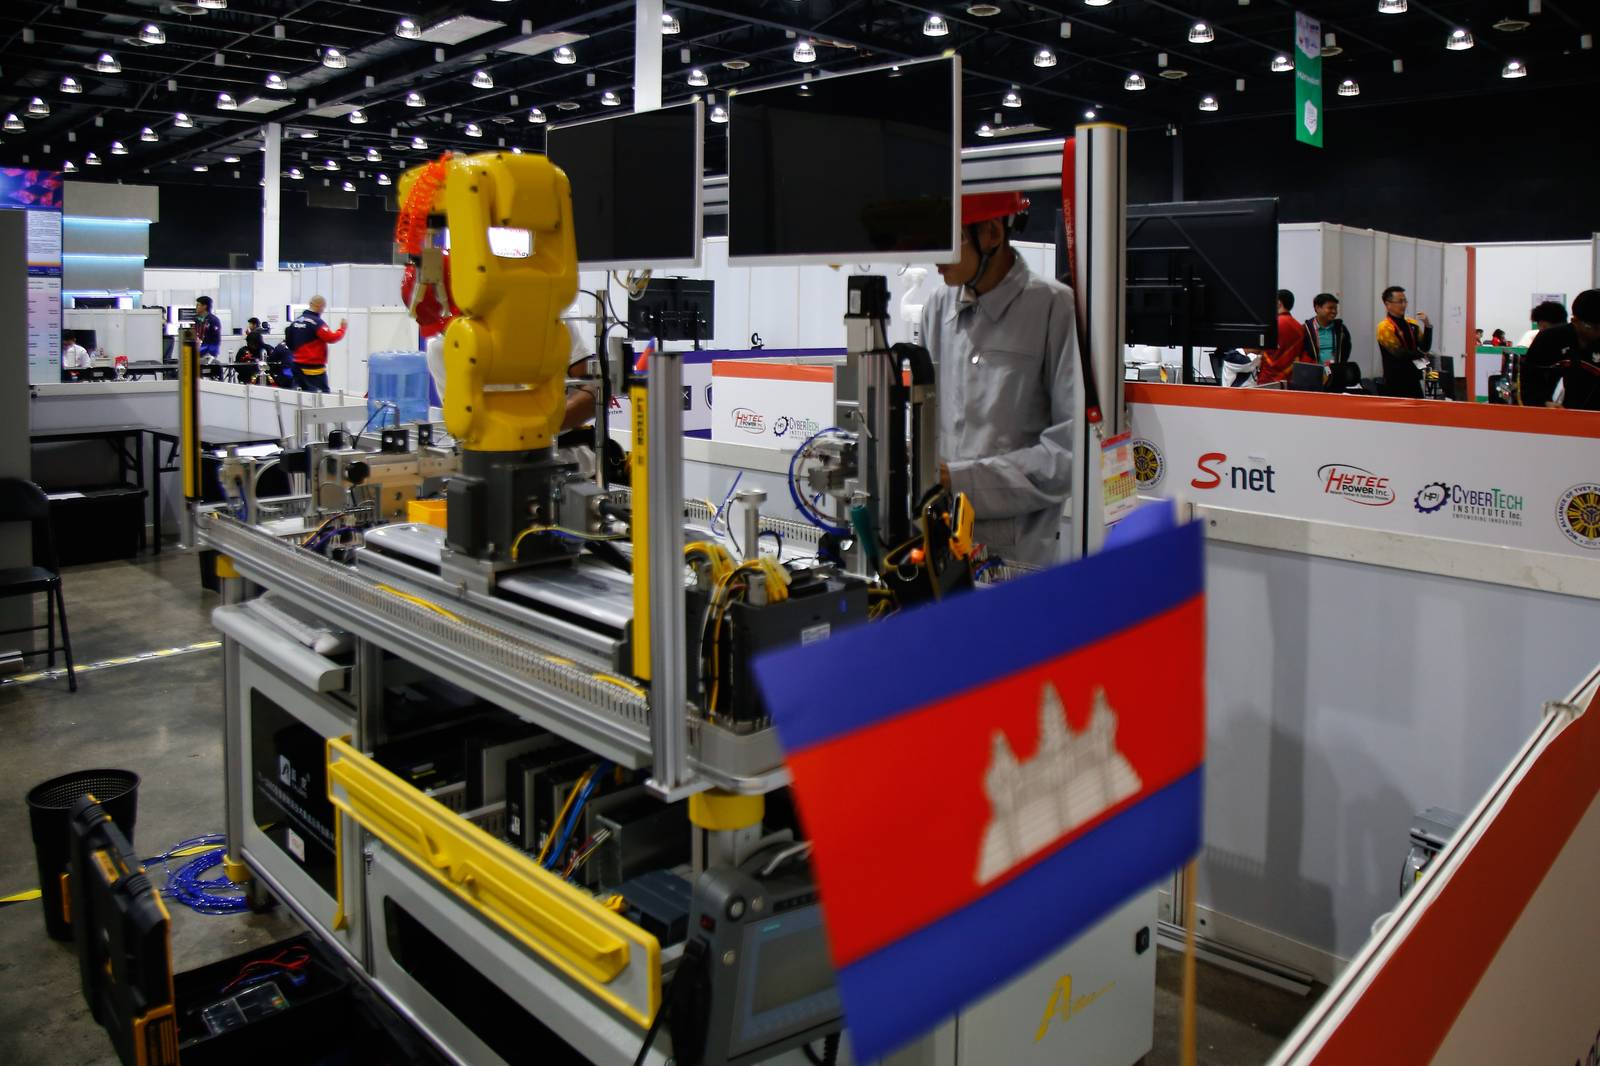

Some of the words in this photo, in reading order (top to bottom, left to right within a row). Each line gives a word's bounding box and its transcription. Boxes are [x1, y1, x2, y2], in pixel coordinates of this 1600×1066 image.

[1325, 468, 1390, 493] HYTEC
[1452, 505, 1505, 519] INSTITUTE
[1508, 511, 1523, 521] Inc.
